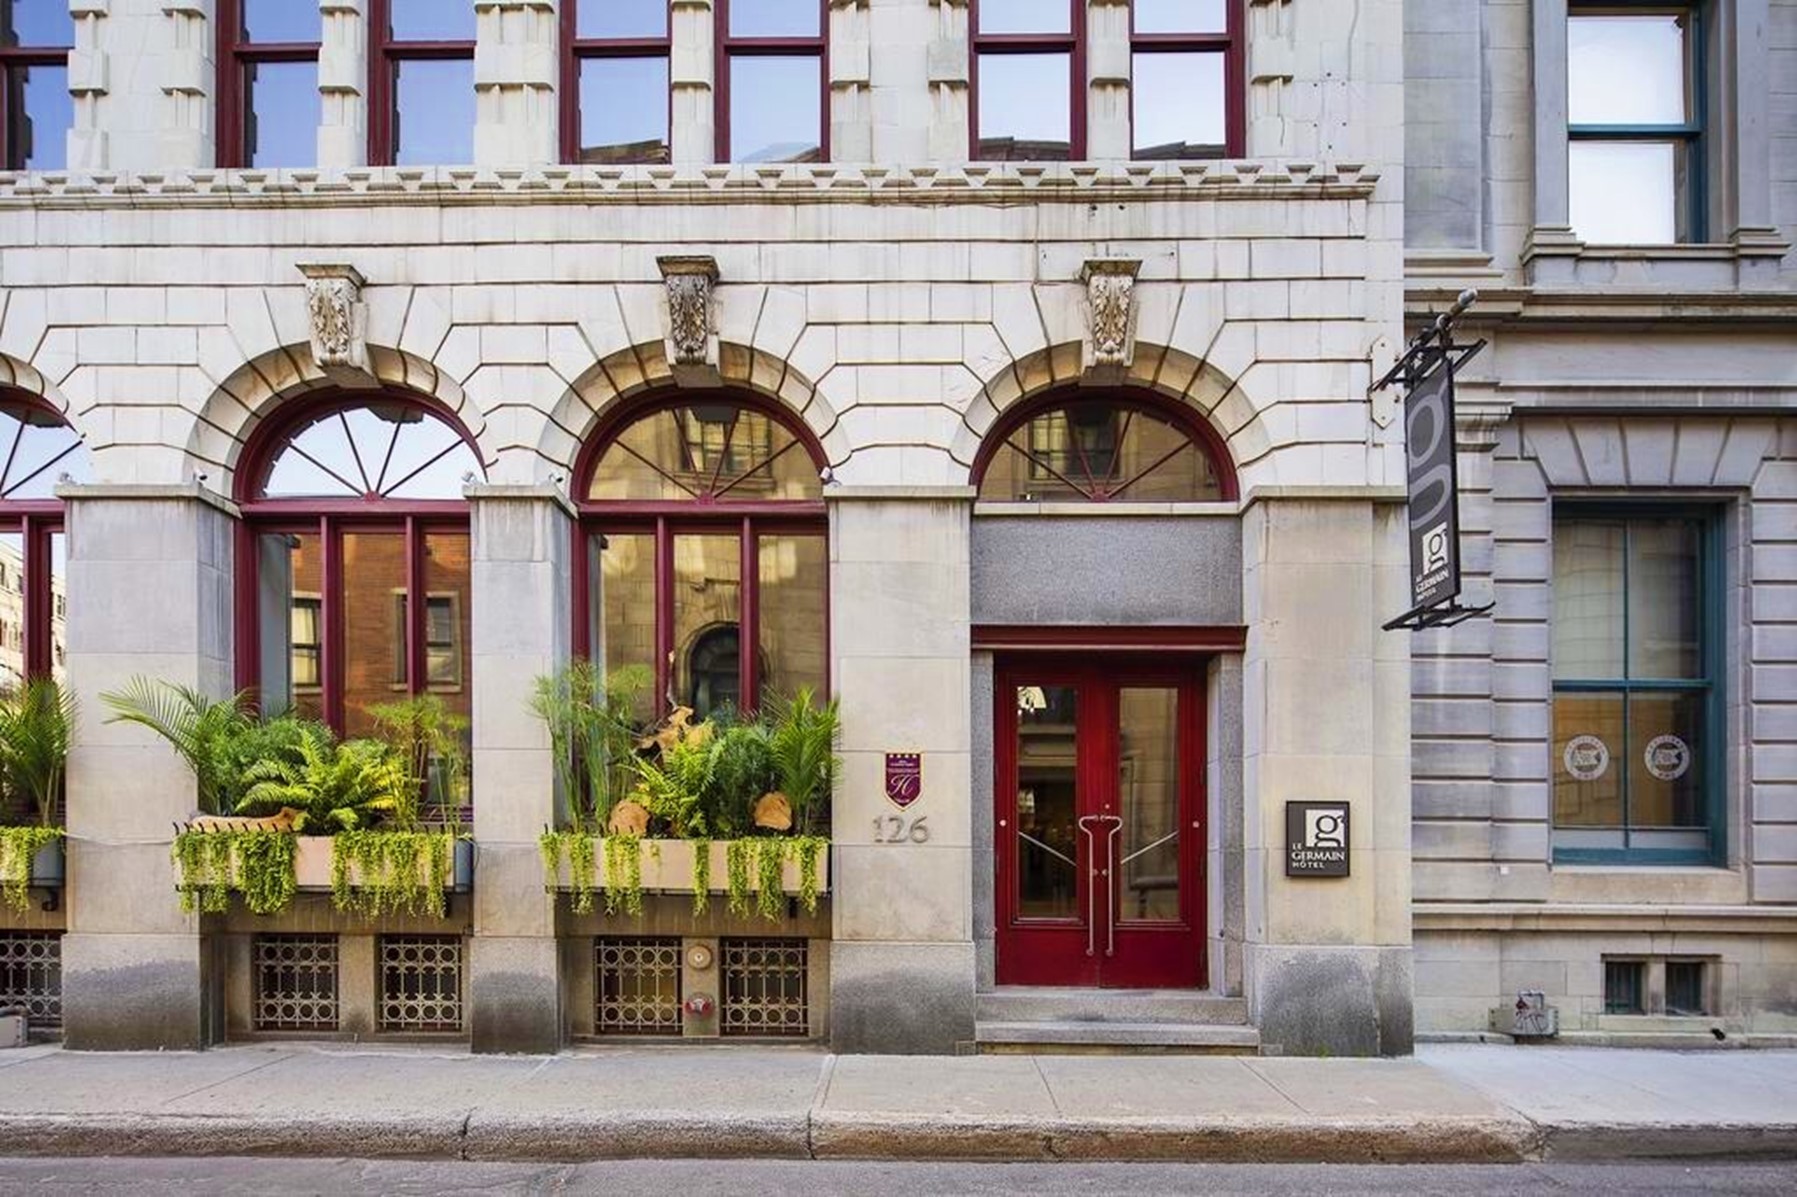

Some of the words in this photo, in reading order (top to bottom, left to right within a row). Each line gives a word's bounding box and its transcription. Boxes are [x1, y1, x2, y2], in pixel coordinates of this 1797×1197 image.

[873, 815, 928, 844] 126
[1292, 842, 1302, 851] LE
[1291, 851, 1345, 861] GERMAIN
